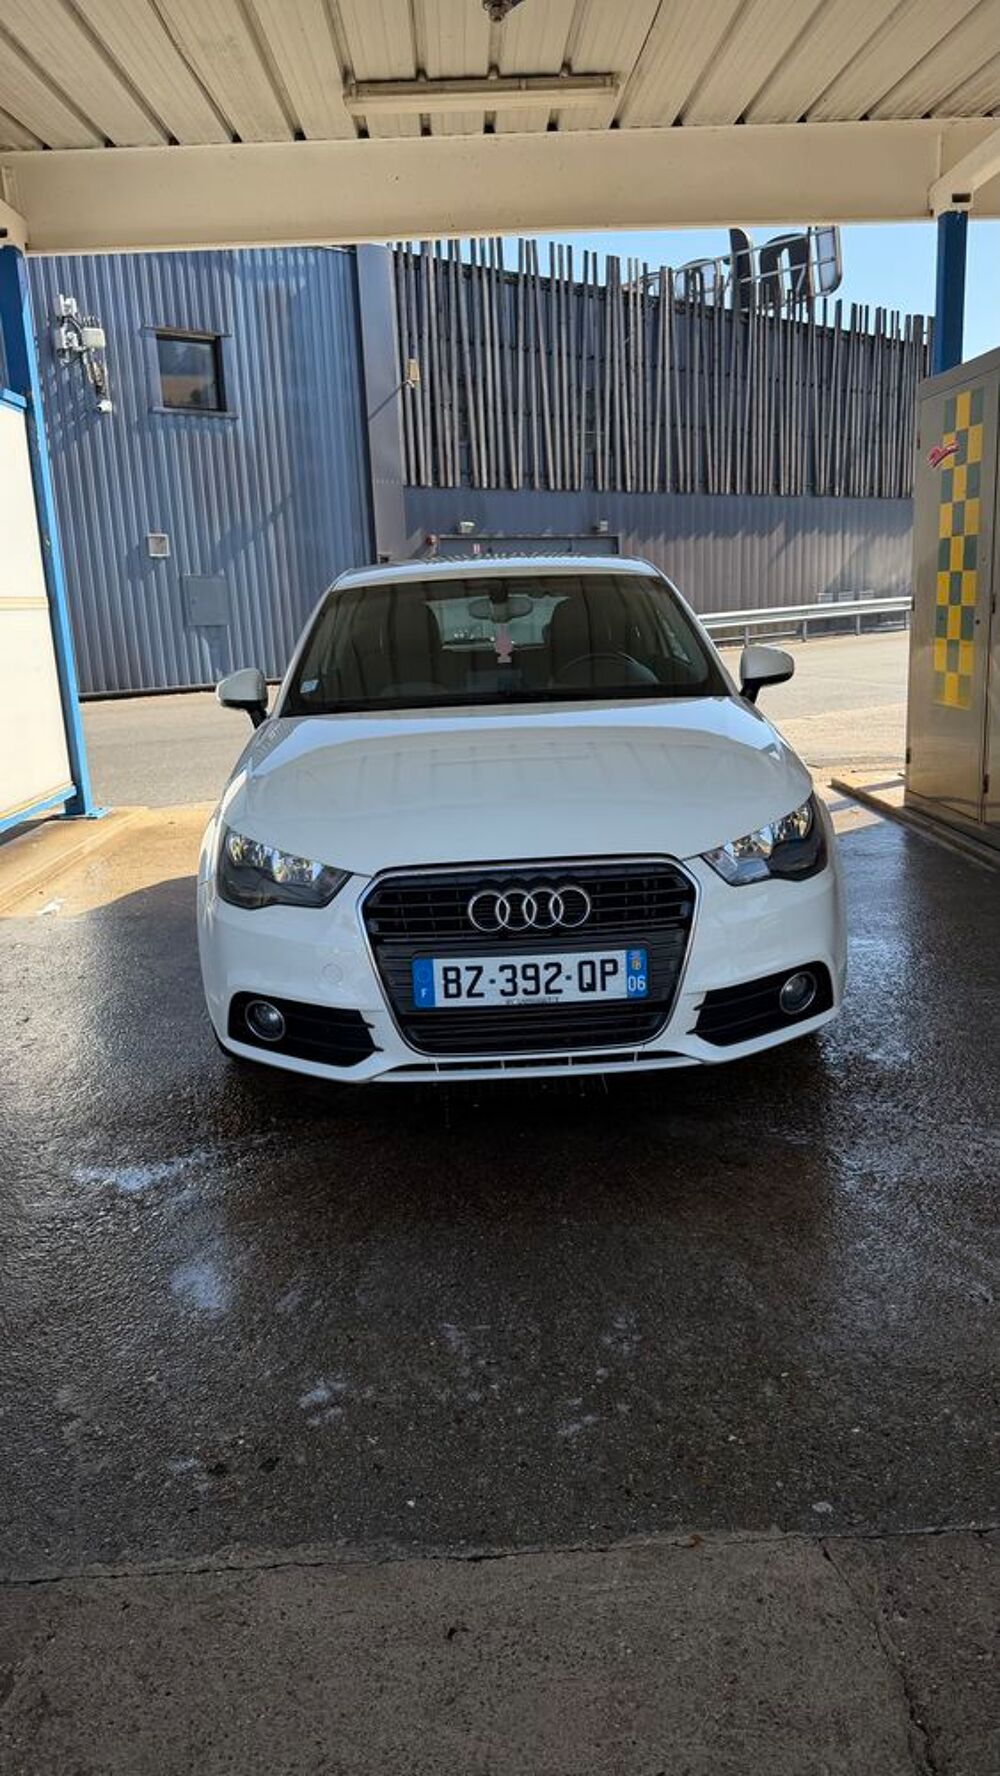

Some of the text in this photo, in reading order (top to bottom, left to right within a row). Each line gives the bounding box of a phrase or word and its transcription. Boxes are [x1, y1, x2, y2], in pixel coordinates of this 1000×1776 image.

[442, 958, 619, 999] BZ-392-QP
[628, 975, 646, 992] 06
[421, 988, 428, 998] F
